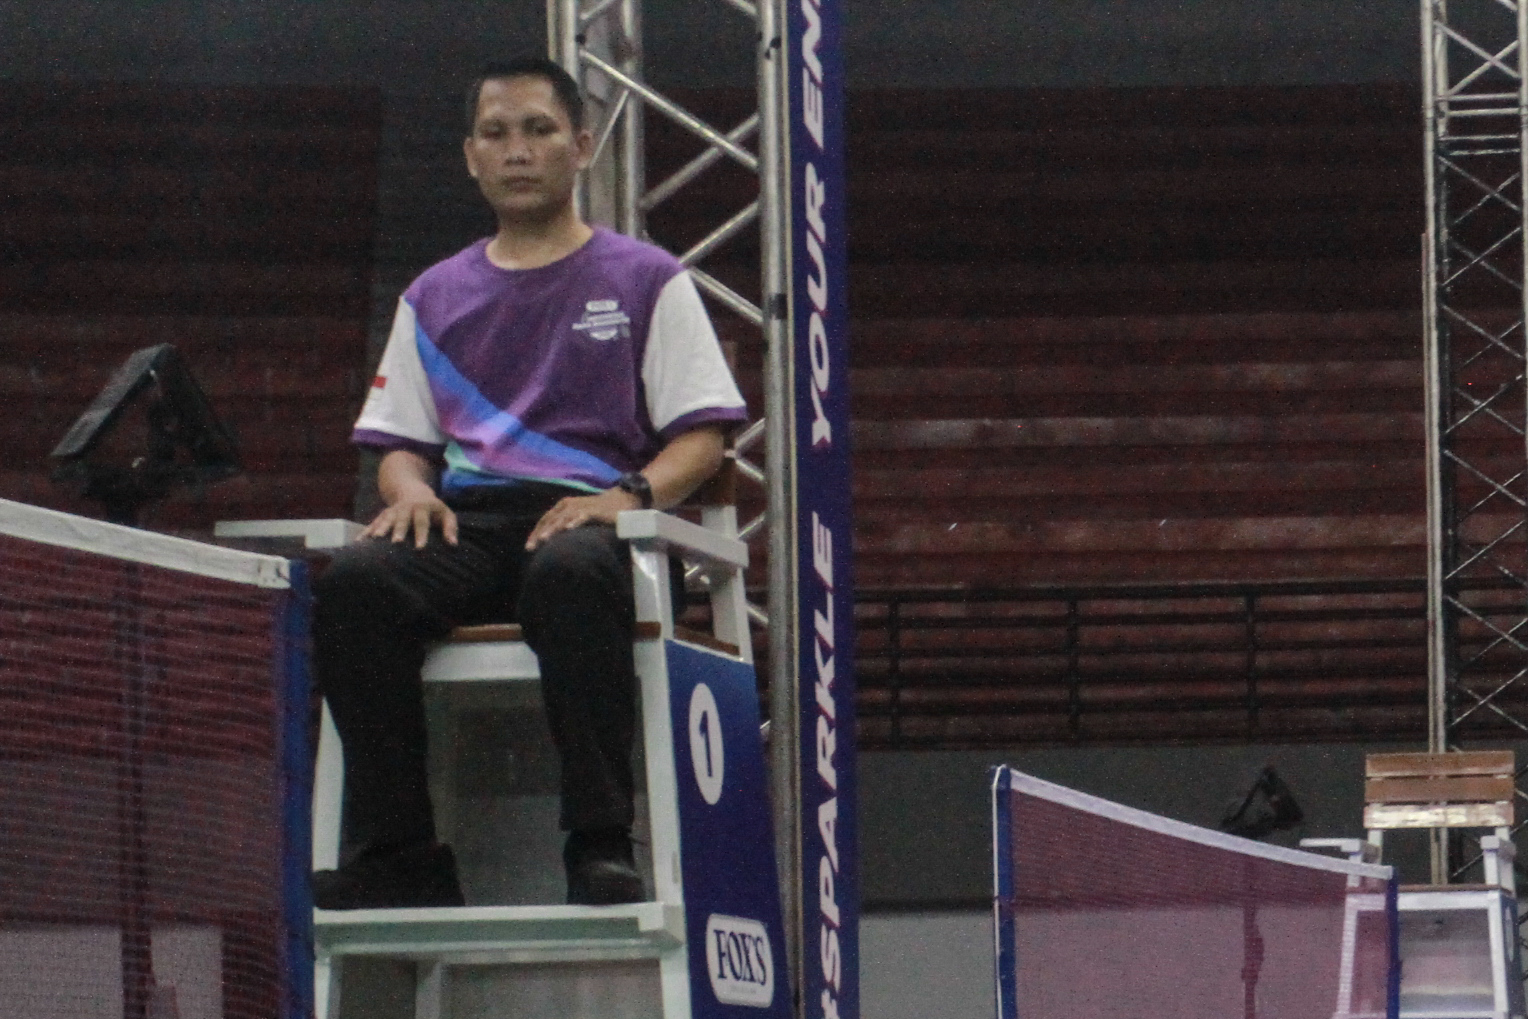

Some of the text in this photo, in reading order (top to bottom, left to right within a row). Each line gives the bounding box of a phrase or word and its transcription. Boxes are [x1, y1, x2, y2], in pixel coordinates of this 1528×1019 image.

[801, 0, 824, 150] EN
[806, 162, 832, 446] YOUR
[698, 709, 713, 777] 1
